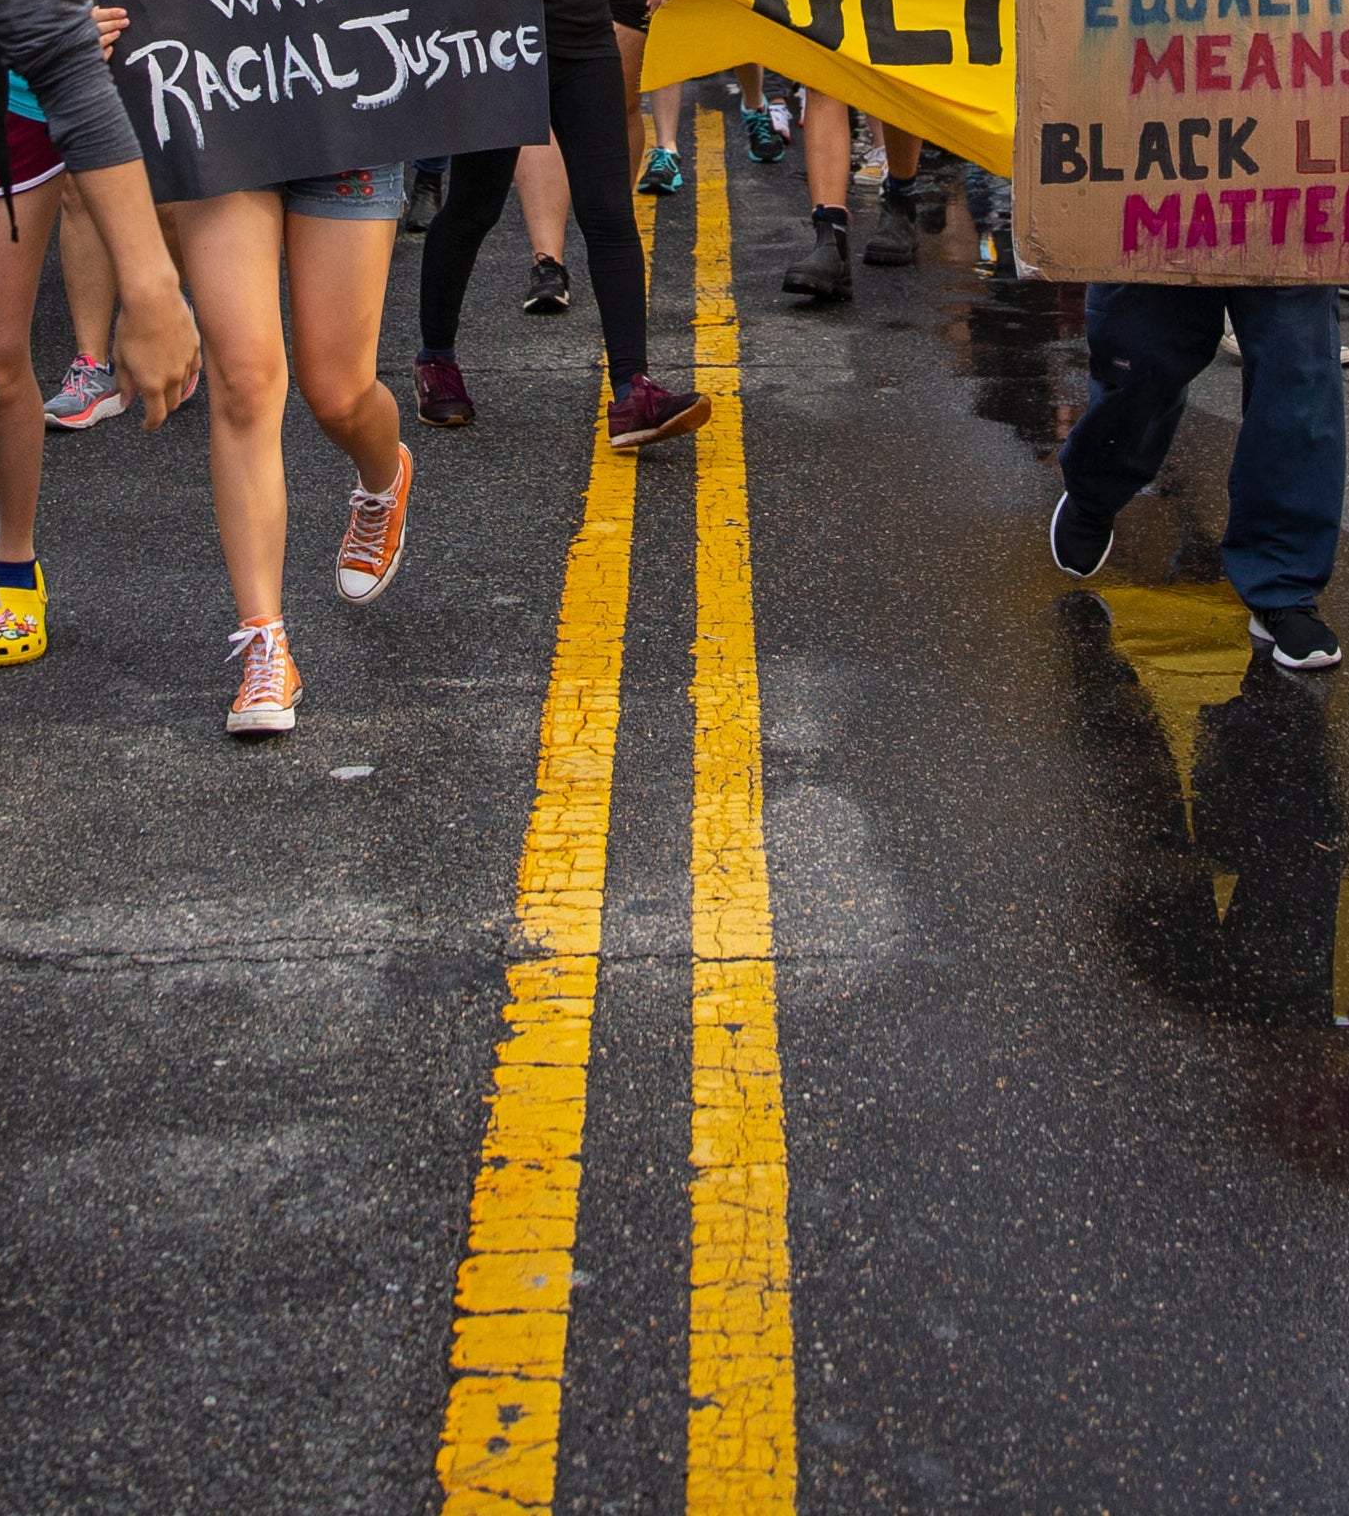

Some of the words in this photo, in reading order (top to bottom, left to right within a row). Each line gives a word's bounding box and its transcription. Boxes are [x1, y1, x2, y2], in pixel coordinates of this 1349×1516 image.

[126, 34, 360, 151] RACIAL
[339, 9, 544, 110] JUSTICE
[1039, 116, 1261, 186] BLACK
